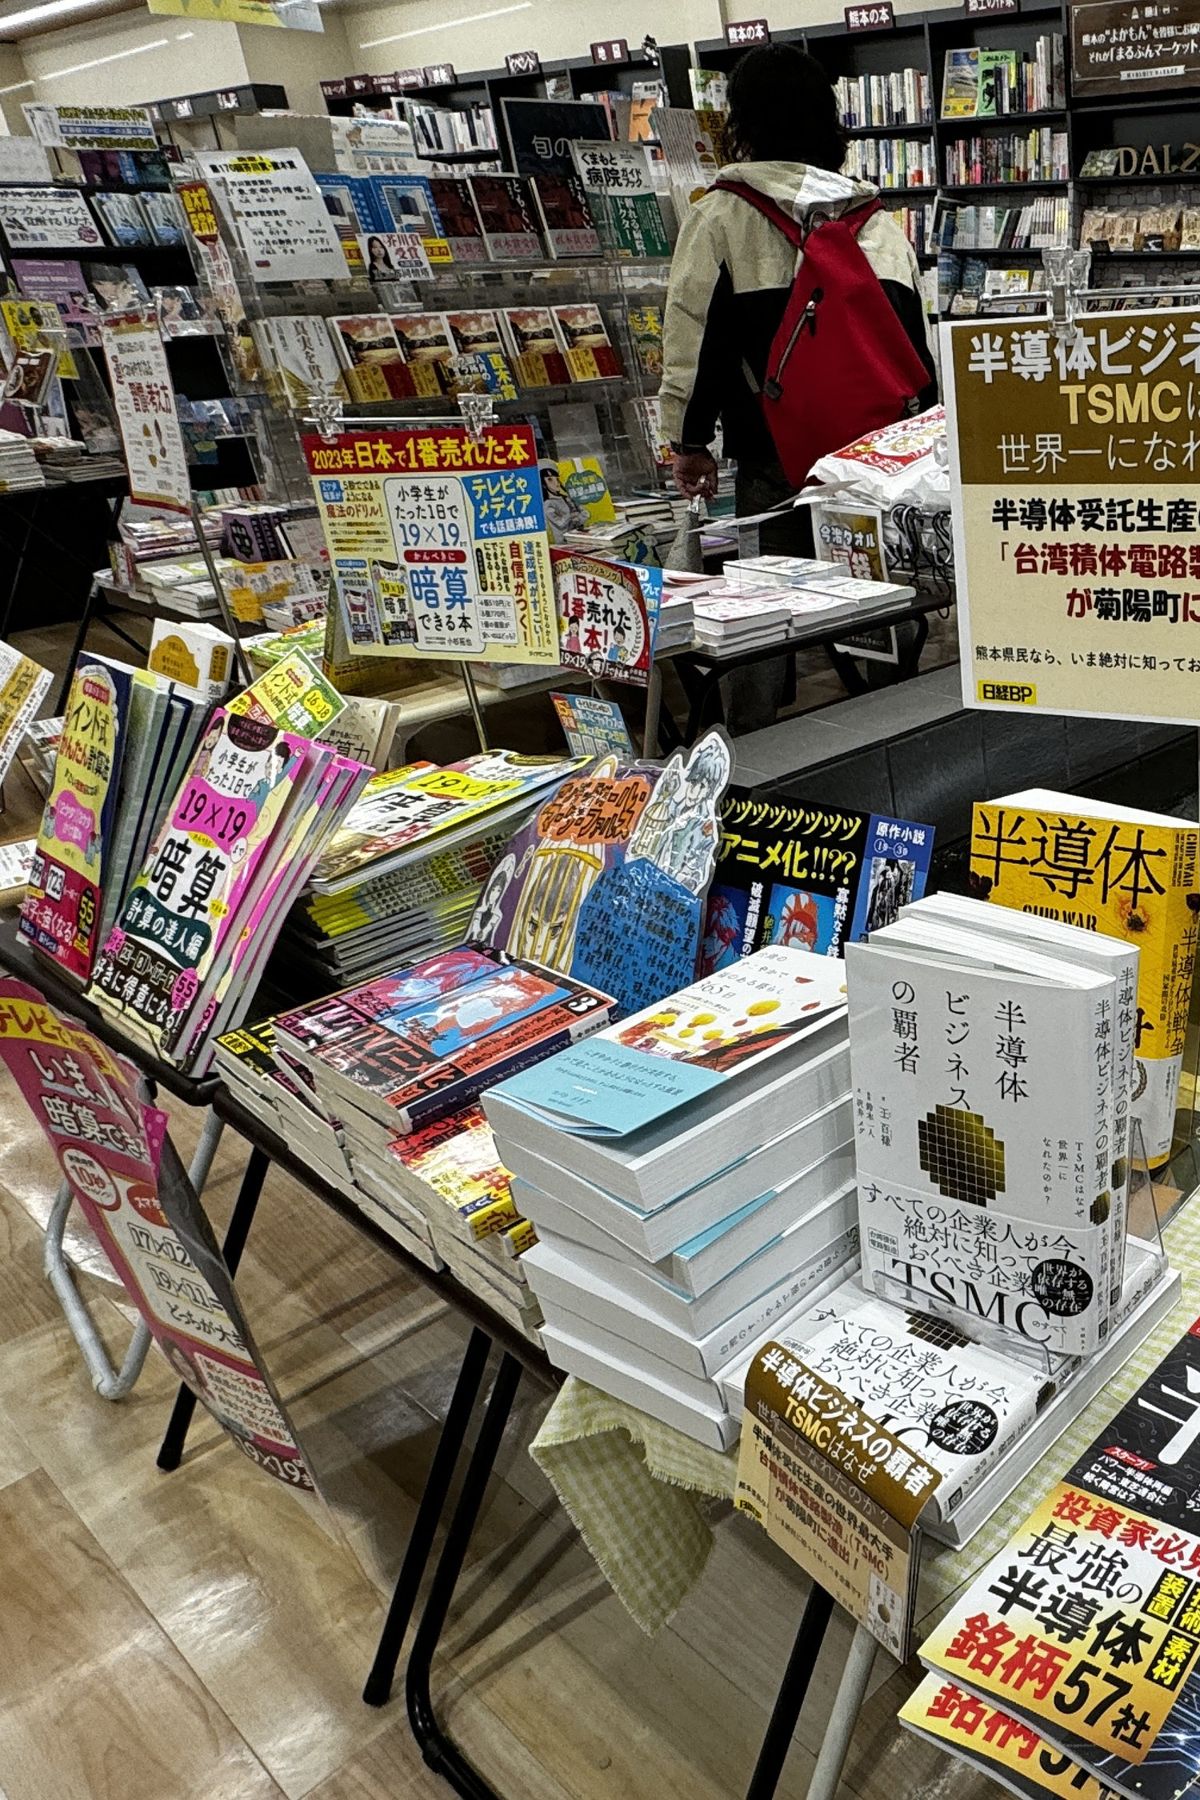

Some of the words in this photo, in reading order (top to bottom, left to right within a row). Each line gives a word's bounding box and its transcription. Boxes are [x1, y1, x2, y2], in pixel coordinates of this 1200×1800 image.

[849, 6, 890, 28] 熊本の本
[581, 153, 618, 166] くまもと
[586, 168, 623, 188] 病院
[313, 434, 530, 469] 2023年日本で1番売れた本
[395, 503, 459, 520] たった1日で
[398, 484, 448, 502] 小学生が
[472, 474, 529, 498] テレビや
[479, 494, 533, 520] メディア
[401, 523, 460, 548] 19×19
[414, 551, 456, 563] かんぺきに
[410, 566, 473, 611] 暗算
[508, 541, 530, 647] 自信がつく！
[562, 592, 632, 631] 1番売れた
[575, 574, 615, 603] 日本で
[418, 615, 473, 634] できる本
[583, 624, 609, 654] 本！
[981, 682, 1034, 703] 日経BP
[72, 701, 110, 747] インド式
[218, 751, 258, 775] 小学生が
[178, 787, 249, 843] 19×19
[875, 821, 927, 846] 原作小説
[151, 837, 227, 919] 暗算
[971, 810, 1169, 909] 半導体
[126, 897, 206, 962] 計算の達人編
[891, 980, 921, 1076] の覇者
[945, 990, 971, 1111] ビジネス
[994, 1000, 1029, 1103] 半導体
[1112, 966, 1134, 1154] 半導体ビジネスの覇者
[1042, 1137, 1053, 1205] なれたのか？
[1057, 1138, 1069, 1182] 世界一に
[1073, 1141, 1085, 1218] TSMCはなぜ
[861, 1183, 1087, 1262] すべての企業人が今、
[903, 1217, 1041, 1270] 絶対に知って
[908, 1243, 1036, 1298] おくべき企業
[1036, 1271, 1088, 1292] 依存する
[1042, 1260, 1084, 1278] 世界が
[891, 1258, 1053, 1343] TSMC
[1041, 1297, 1083, 1314] の存在
[808, 1306, 1010, 1417] すべての企業人が今、
[828, 1339, 963, 1404] 絶対に知って
[811, 1356, 938, 1428] おくべき企業
[760, 1347, 935, 1498] 半導体ビジネスの覇者
[784, 1397, 879, 1485] TSMCはなぜ
[1017, 1521, 1144, 1606] 最強の
[987, 1563, 1155, 1671] 半導体
[1151, 1570, 1184, 1620] 装置
[944, 1611, 1154, 1752] 銘柄57社
[1152, 1633, 1195, 1687] 素材
